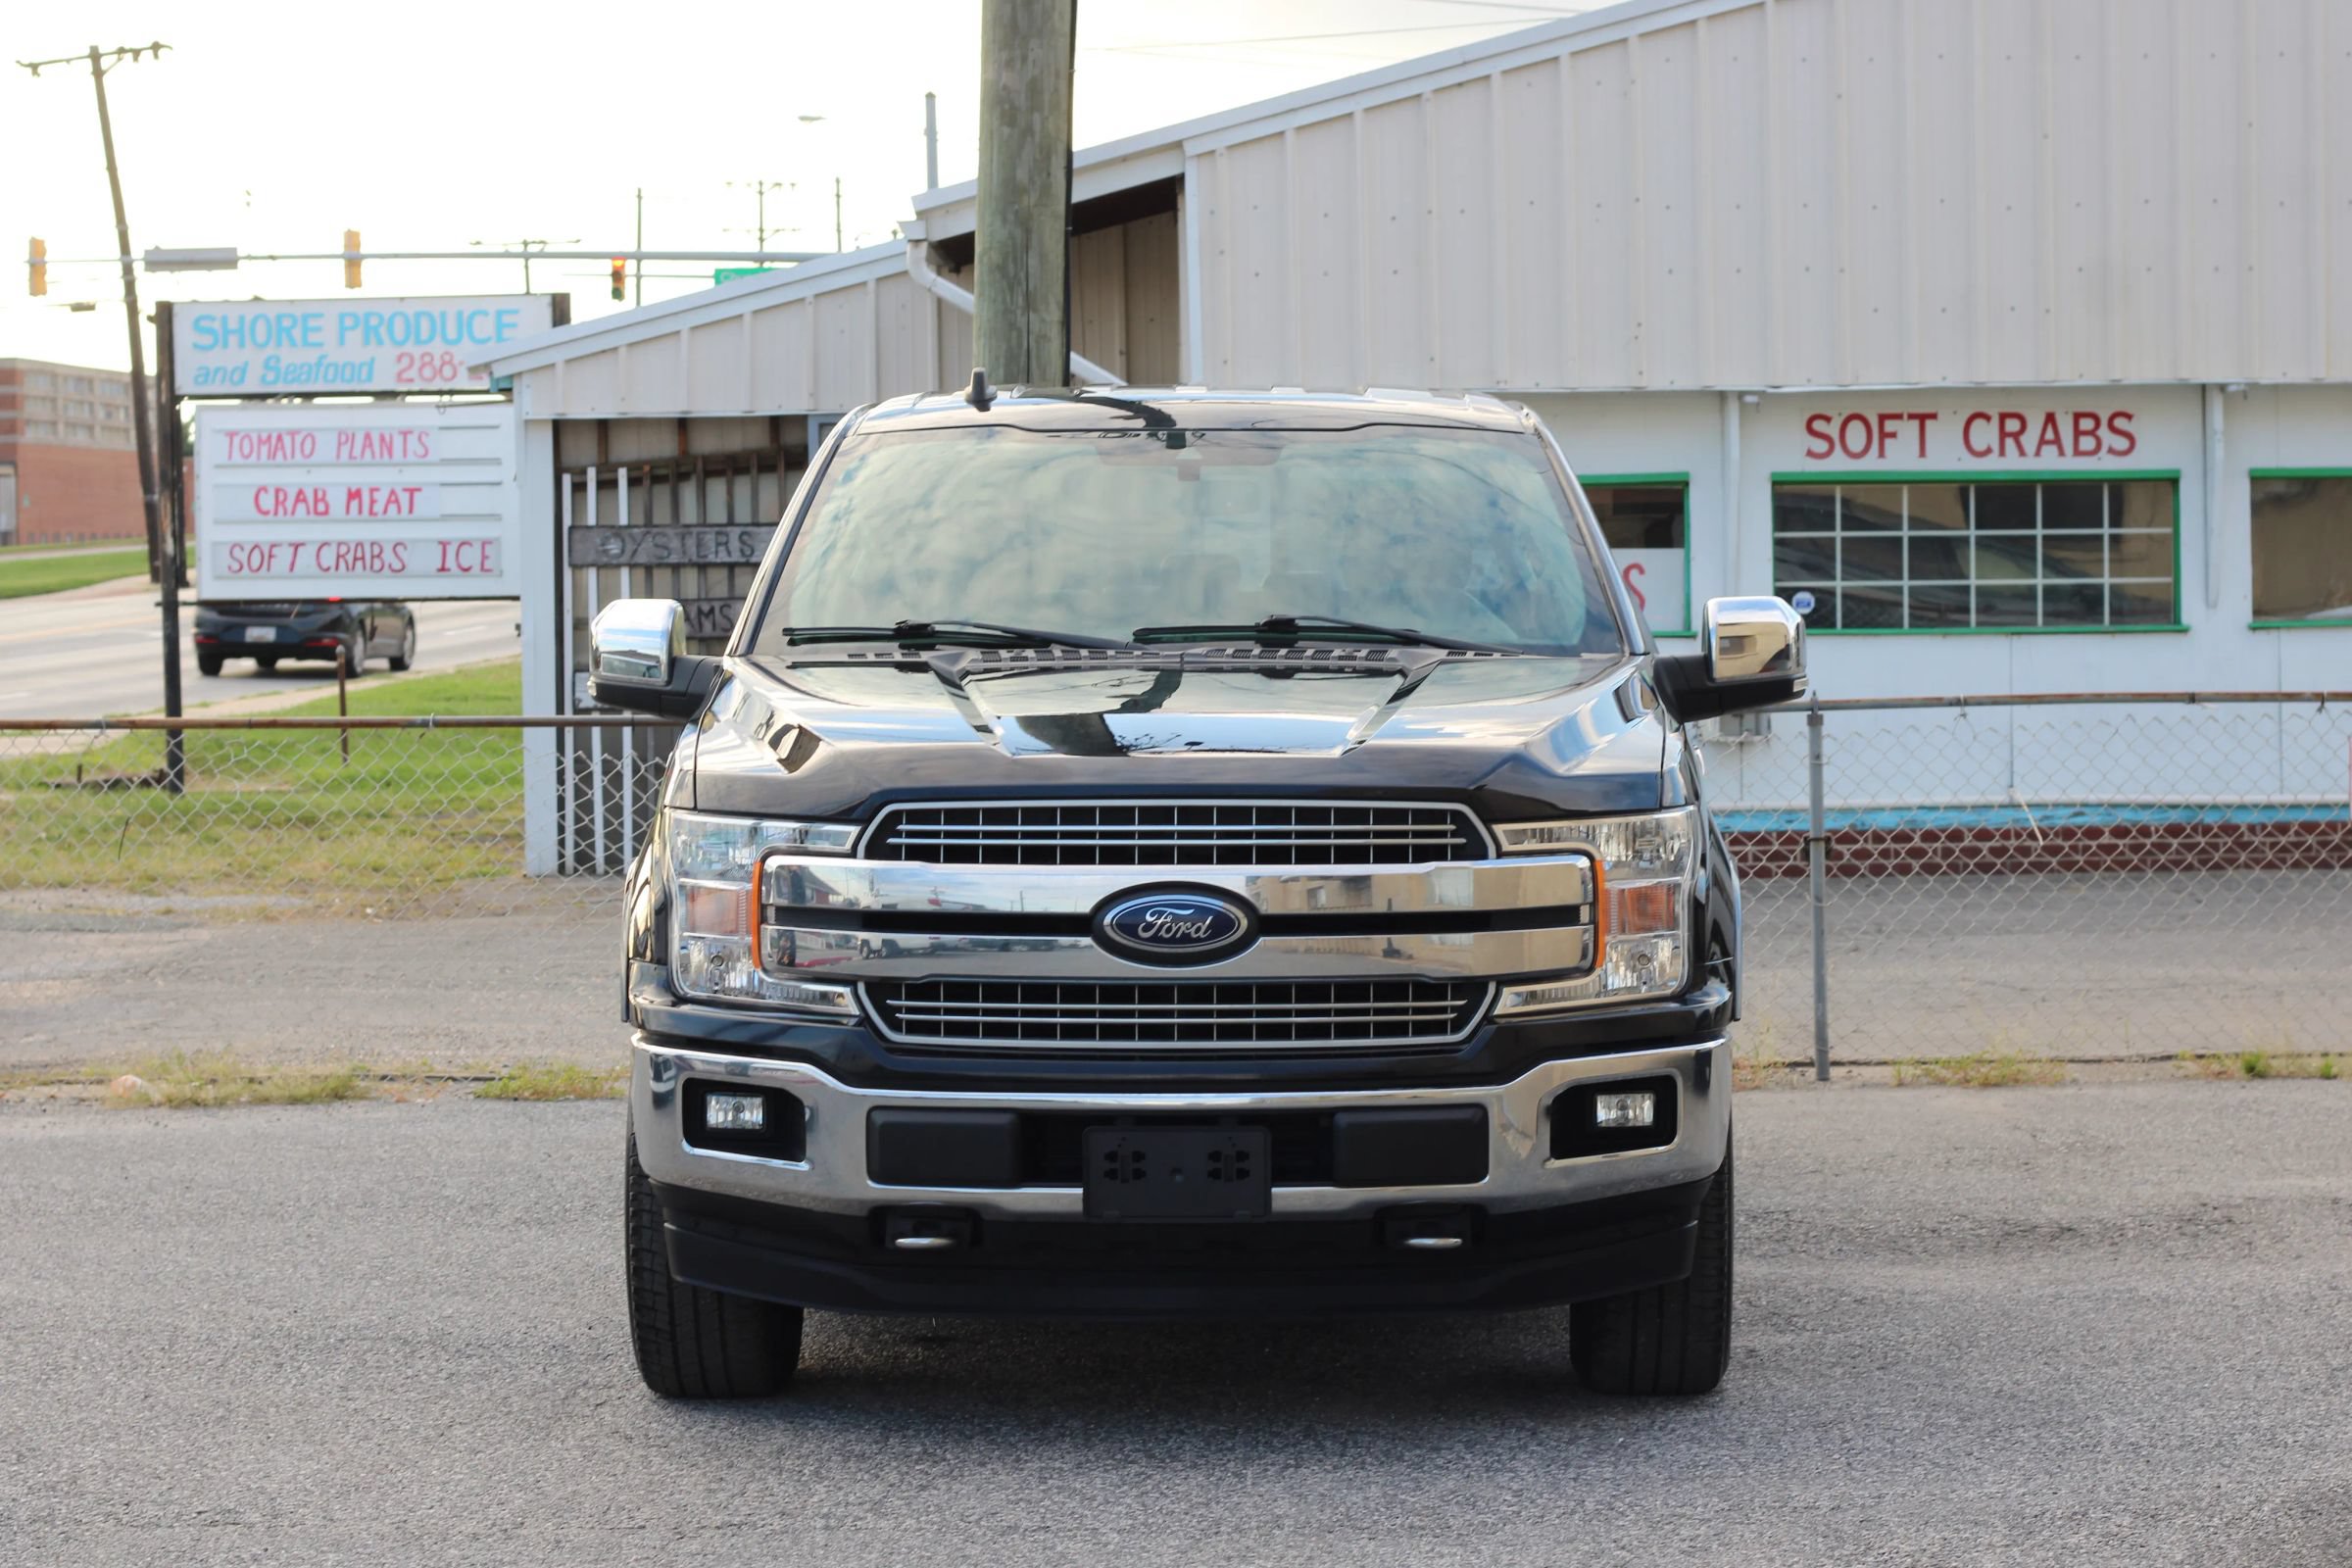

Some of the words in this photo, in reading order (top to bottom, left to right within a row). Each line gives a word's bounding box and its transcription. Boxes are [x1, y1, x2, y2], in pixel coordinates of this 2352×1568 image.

[191, 312, 324, 352] SHORE
[337, 308, 519, 347] PRODUCE
[194, 360, 250, 386] and
[260, 353, 376, 386] Seafood
[225, 429, 317, 461] TOMATO
[336, 427, 430, 460] PLANTS
[1804, 410, 1939, 461] SOFT
[1962, 408, 2137, 459] CRABS
[253, 485, 330, 516] CRAB
[344, 486, 423, 517] MEAT
[228, 541, 307, 574] SOFT
[315, 541, 407, 573] CRABS
[436, 540, 494, 573] ICE
[600, 530, 756, 562] OYSTERS
[1137, 906, 1214, 939] Ford
